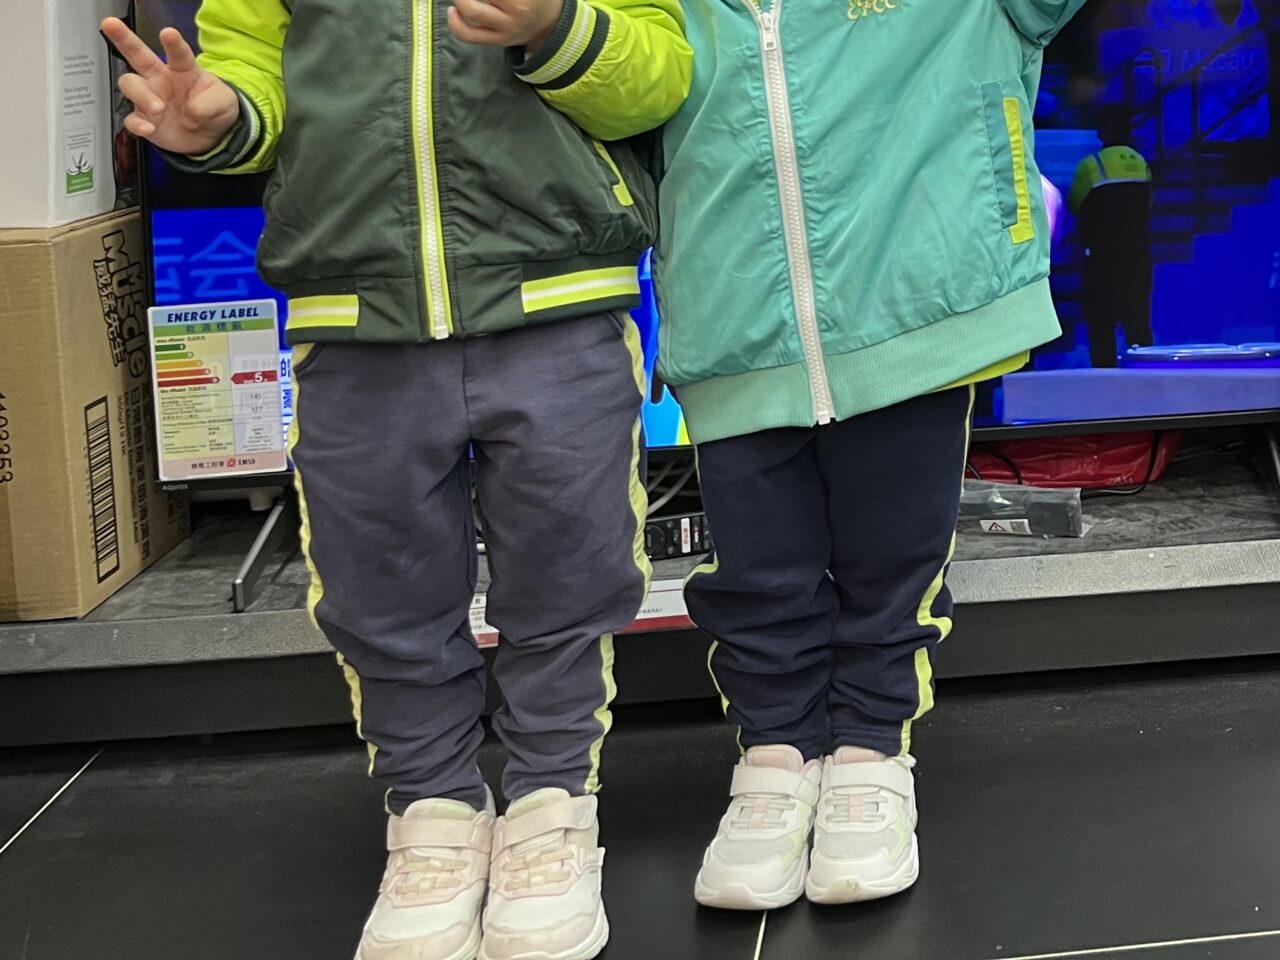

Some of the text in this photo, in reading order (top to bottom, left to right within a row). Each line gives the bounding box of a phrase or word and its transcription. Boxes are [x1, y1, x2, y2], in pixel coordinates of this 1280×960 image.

[167, 307, 259, 323] ENERGY LABEL
[254, 372, 263, 383] 5
[162, 483, 188, 491] AQUOS
